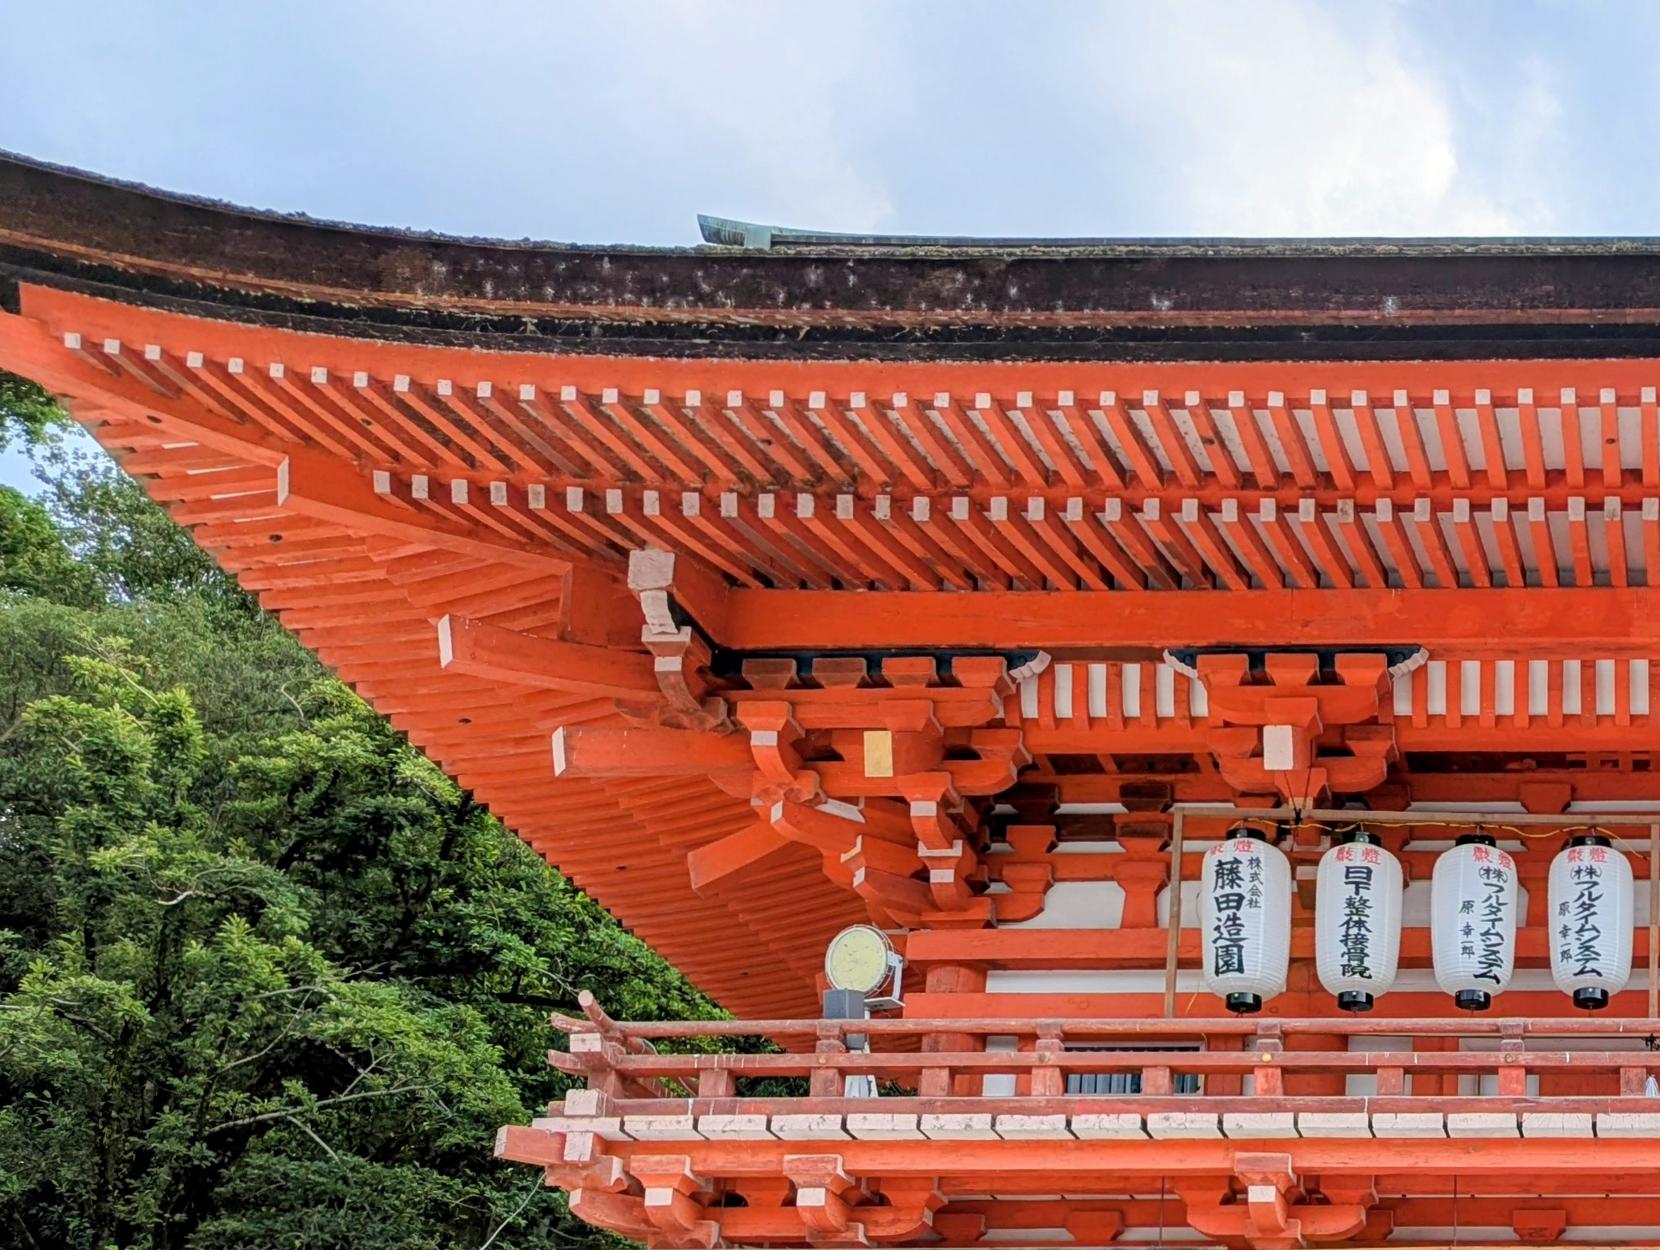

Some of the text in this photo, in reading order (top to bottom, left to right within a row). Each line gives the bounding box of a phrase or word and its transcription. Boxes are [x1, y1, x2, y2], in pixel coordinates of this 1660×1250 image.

[1212, 857, 1250, 977] 藤田造園
[1339, 866, 1373, 979] 日下整体接骨院
